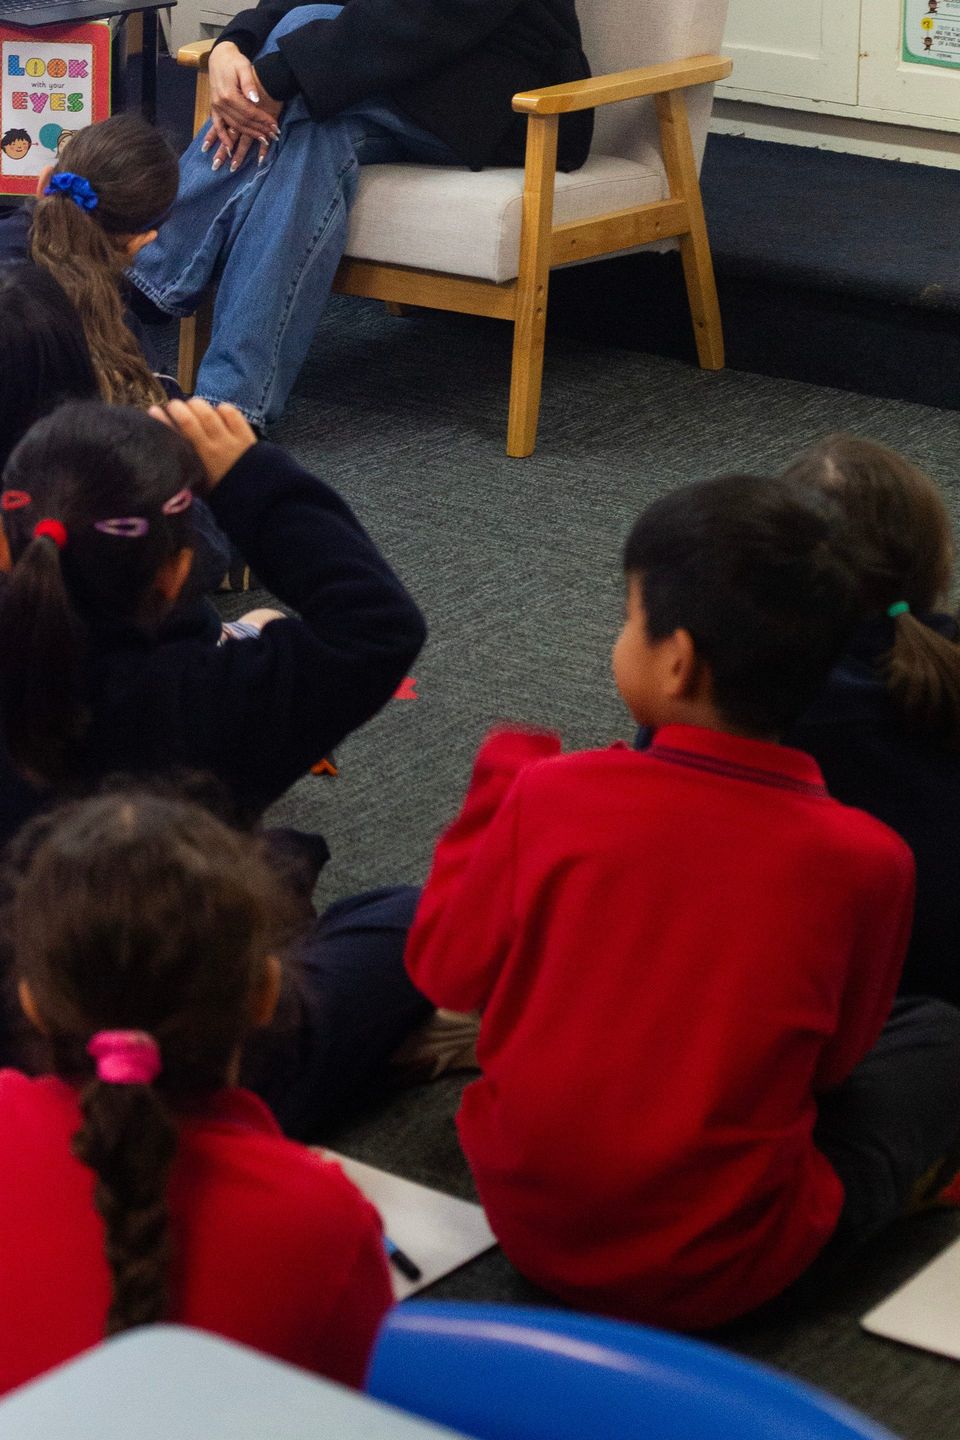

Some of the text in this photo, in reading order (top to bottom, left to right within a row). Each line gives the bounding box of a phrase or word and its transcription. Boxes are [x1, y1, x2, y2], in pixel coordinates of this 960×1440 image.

[8, 54, 89, 78] LOOK
[49, 82, 65, 90] your
[12, 91, 84, 113] EYES
